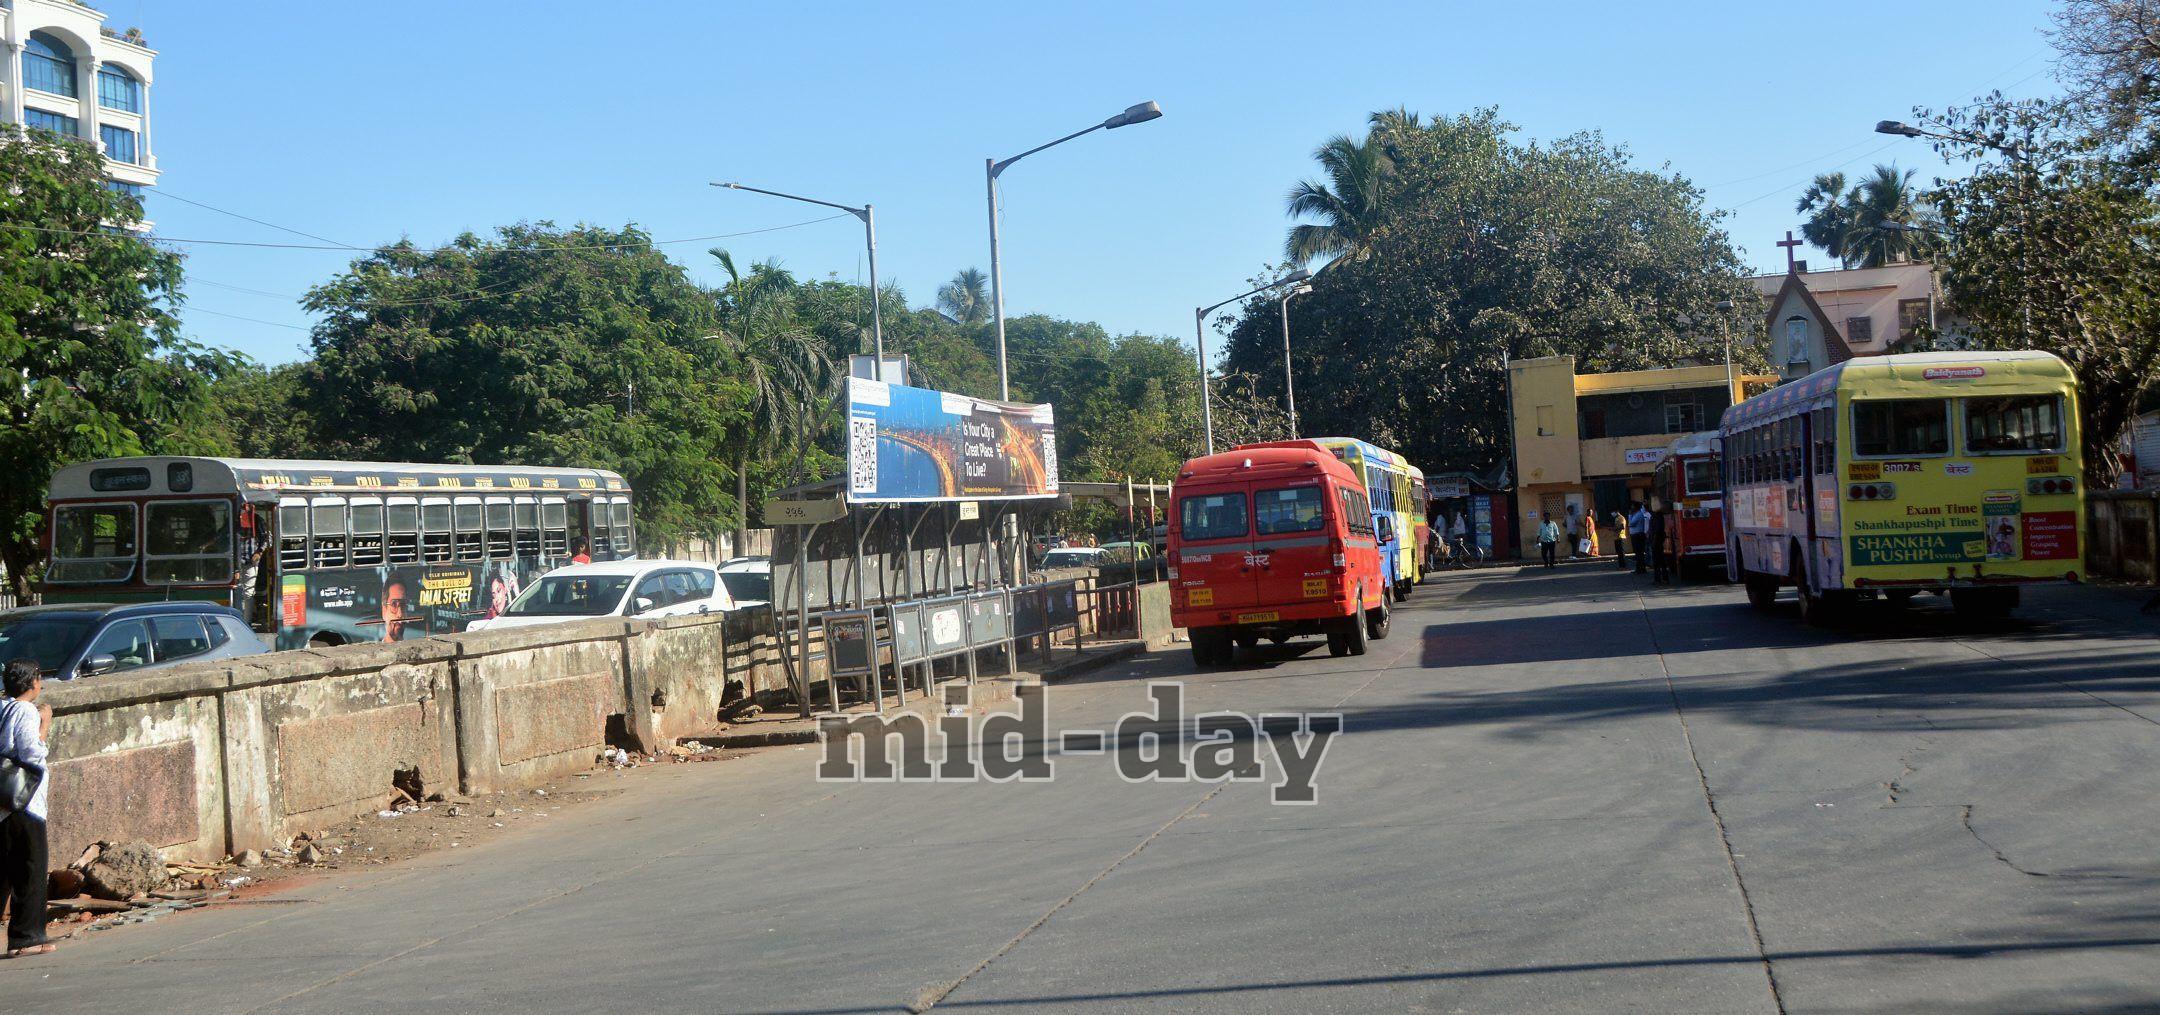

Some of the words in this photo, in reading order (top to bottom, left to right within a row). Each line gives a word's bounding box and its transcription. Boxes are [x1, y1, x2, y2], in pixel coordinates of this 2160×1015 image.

[968, 422, 981, 437] Your
[980, 422, 991, 441] City
[964, 441, 980, 457] Great
[980, 443, 994, 458] Place
[965, 461, 972, 476] To
[973, 461, 987, 477] Live?
[1906, 505, 1941, 515] Exam
[1945, 504, 1978, 514] Time
[1854, 518, 1945, 531] Shankhapushpi
[1950, 518, 1979, 527] Time
[1858, 536, 1945, 550] SHANKHA
[1244, 551, 1270, 567] बेस्ट
[1870, 549, 1934, 562] PUSHPI
[419, 589, 442, 606] DALAL
